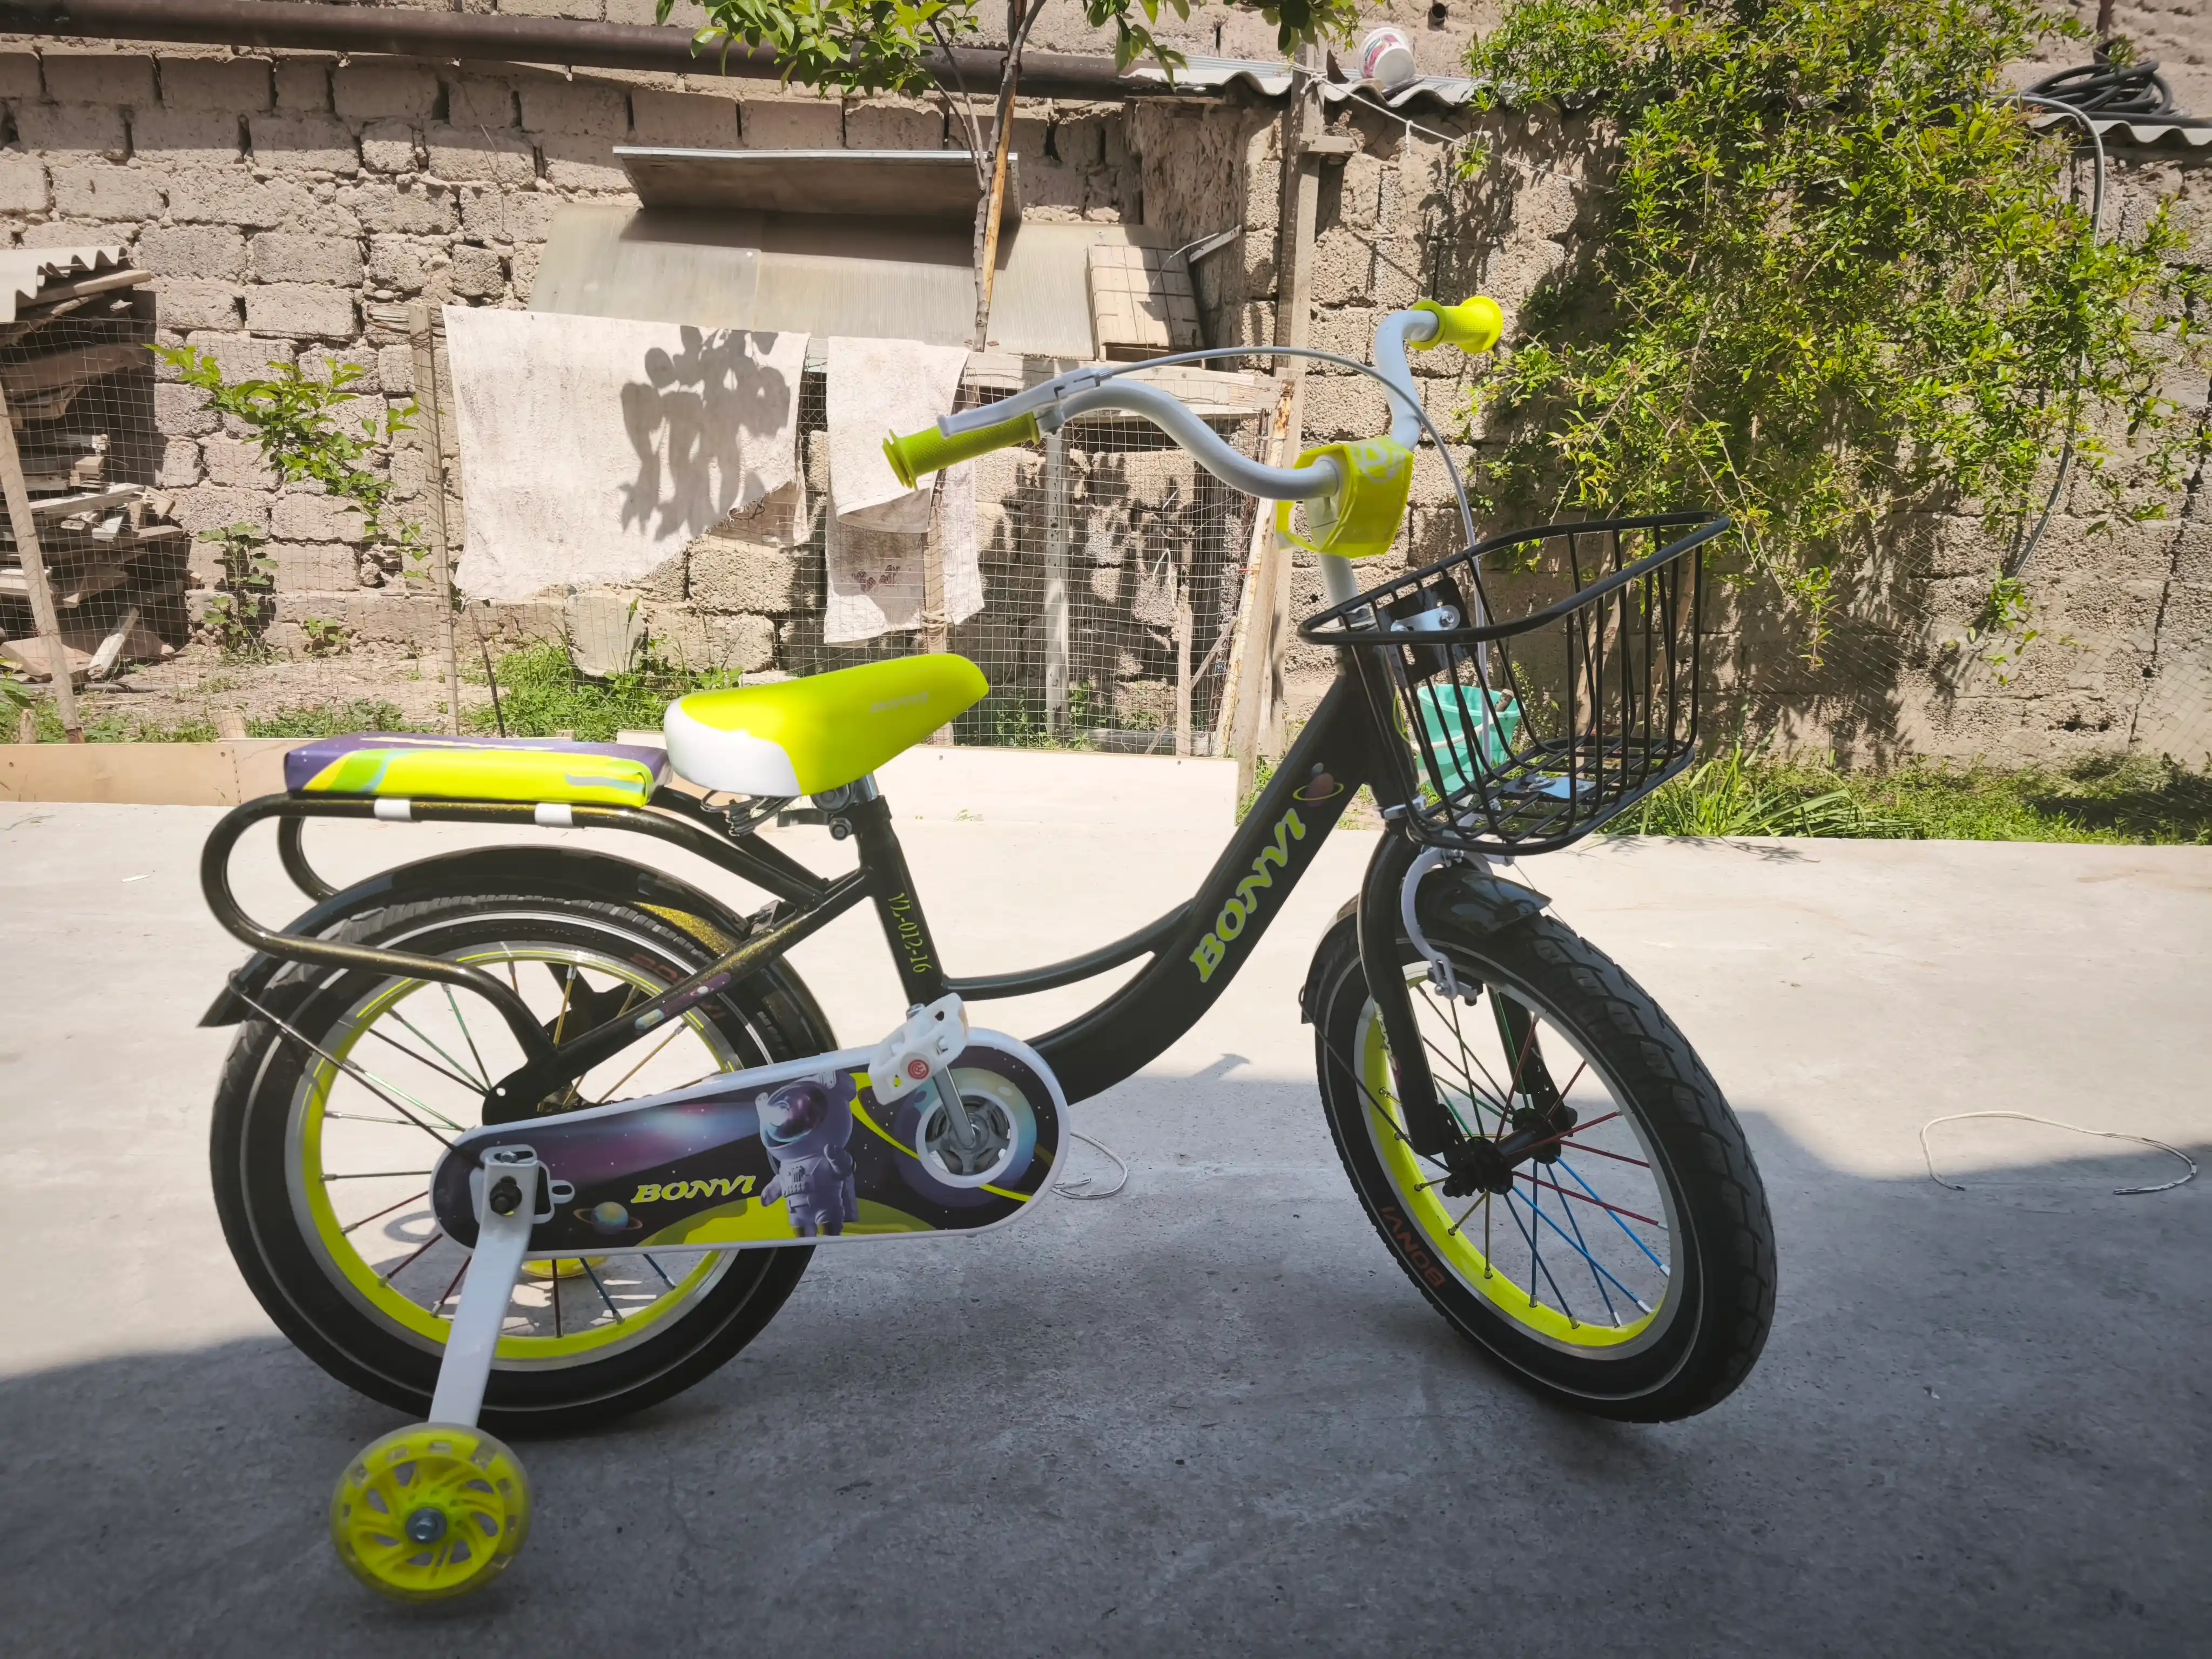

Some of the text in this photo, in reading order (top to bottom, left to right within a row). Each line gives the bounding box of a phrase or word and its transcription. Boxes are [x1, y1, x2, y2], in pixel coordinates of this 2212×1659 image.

[888, 892, 932, 973] VL-012-16
[1189, 808, 1306, 983] BONVI
[631, 1175, 757, 1203] BONVI
[1380, 1206, 1446, 1287] BONVI
